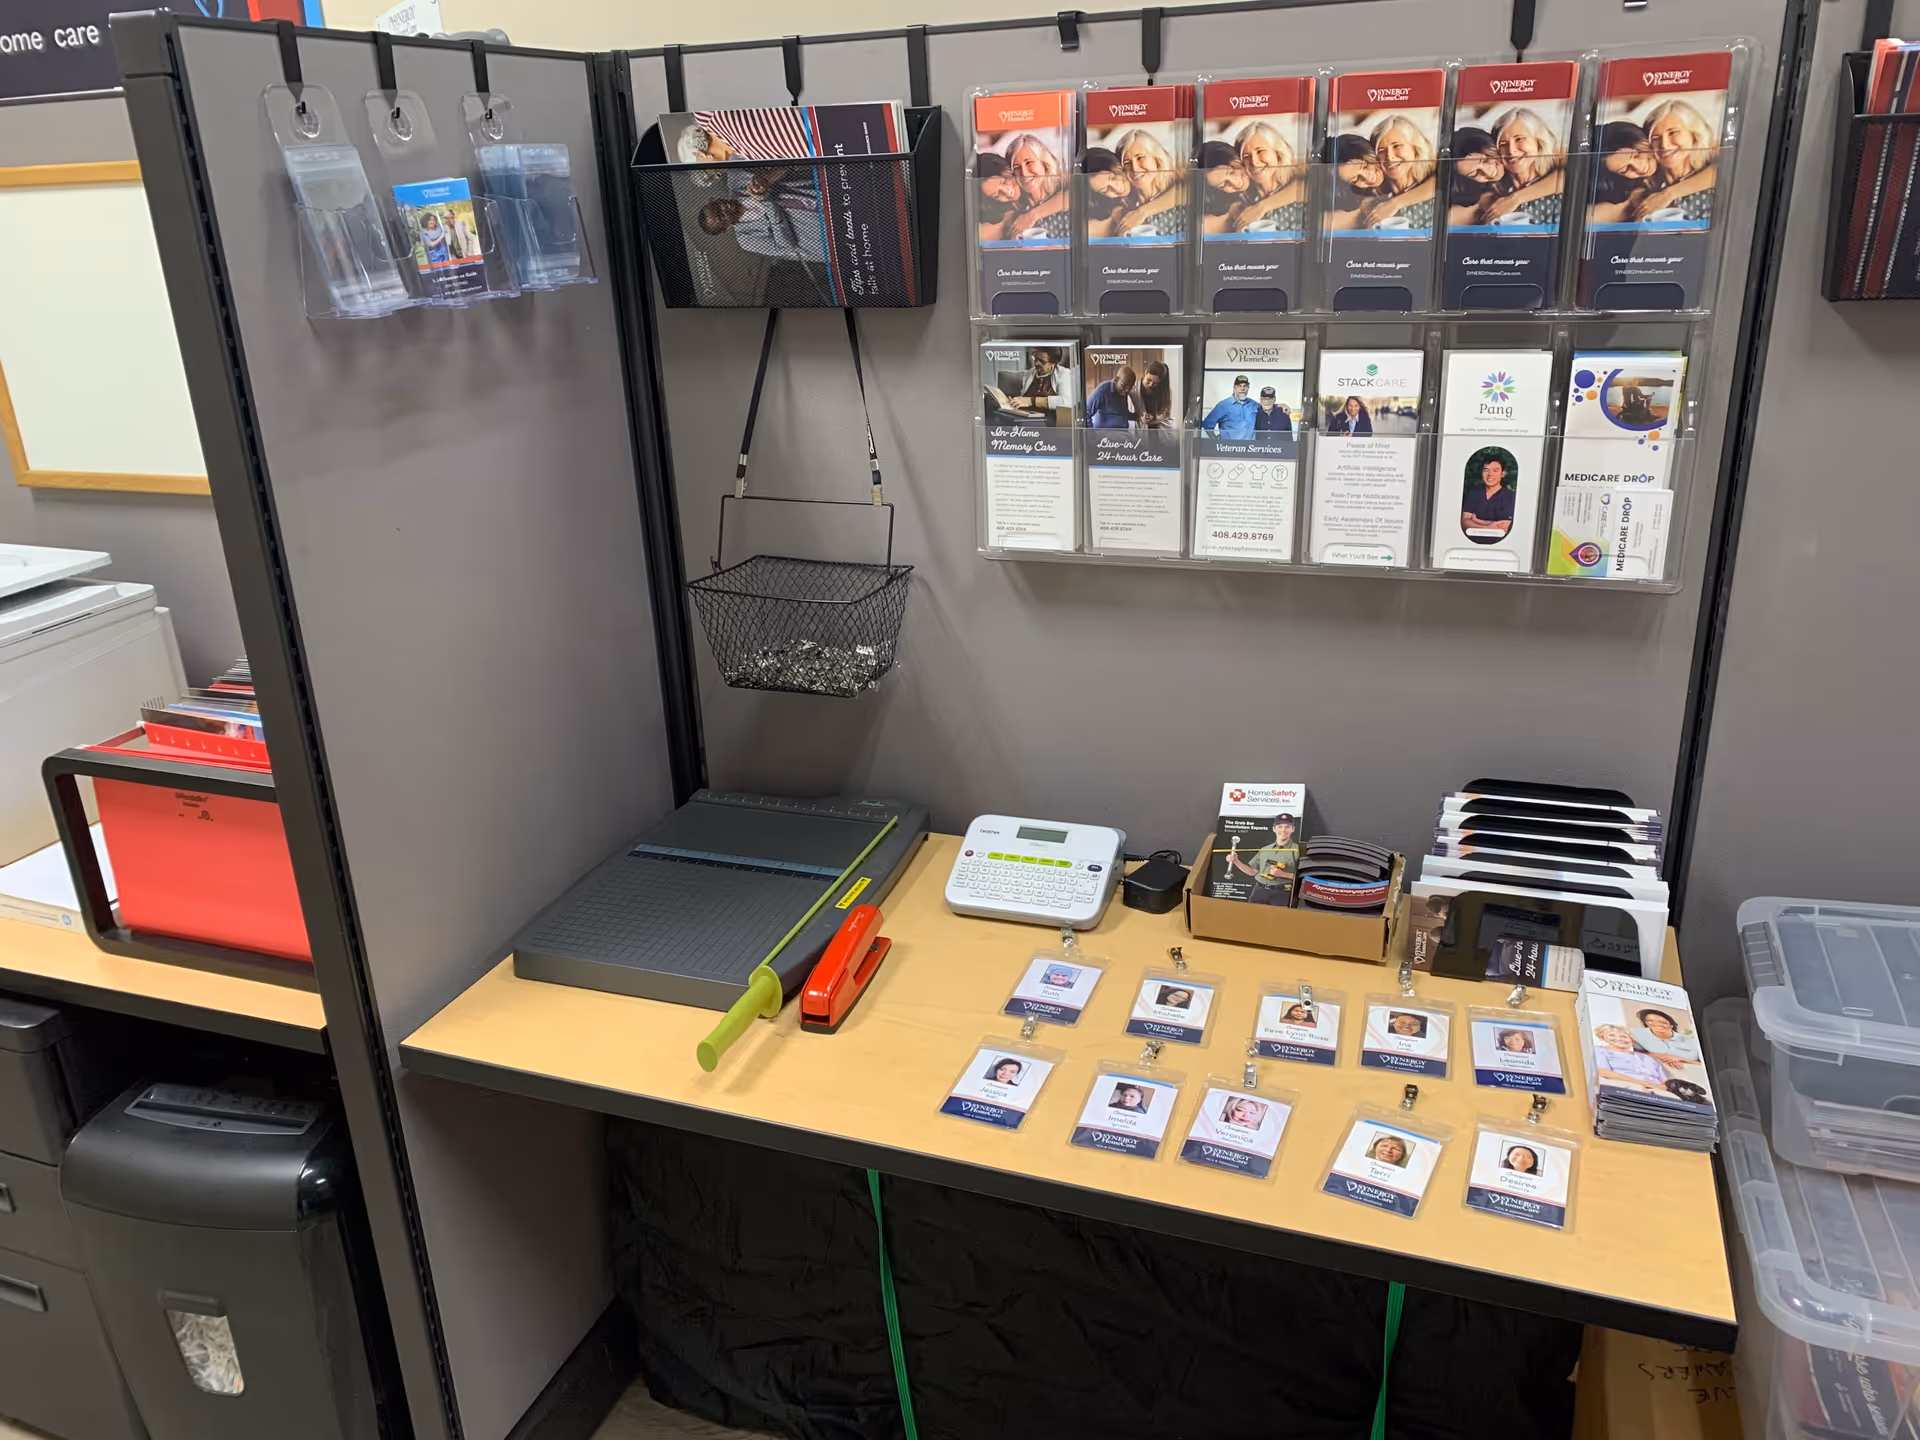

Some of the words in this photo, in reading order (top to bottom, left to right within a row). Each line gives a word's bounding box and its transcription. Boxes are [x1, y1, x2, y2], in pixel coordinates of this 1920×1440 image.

[54, 25, 100, 47] care
[1654, 70, 1693, 80] SYNERGY
[1654, 76, 1691, 86] HomeCare
[1500, 79, 1537, 89] SYNERGY
[1500, 85, 1534, 93] HomeCare
[1376, 88, 1412, 96] SYNERGY
[1377, 94, 1410, 102] HomeCare
[1239, 95, 1271, 103] SYNERGY
[1239, 100, 1269, 108] HomeCare
[1118, 104, 1148, 112] SYNERGY
[1118, 109, 1147, 117] HomeCare
[834, 143, 852, 189] prevnt
[841, 193, 851, 206] to
[843, 210, 855, 239] tools
[861, 223, 873, 257] home
[846, 244, 859, 266] and
[1611, 255, 1629, 264] Care
[1630, 255, 1646, 263] that
[1667, 256, 1683, 265] you
[864, 260, 874, 272] at
[1218, 263, 1233, 272] Care
[1266, 264, 1279, 272] you
[1346, 260, 1361, 269] Care
[1363, 260, 1377, 268] that
[1396, 262, 1411, 270] you
[1462, 257, 1478, 265] Care
[1480, 257, 1495, 265] that
[1515, 258, 1530, 267] you
[1102, 267, 1116, 275] Care
[1148, 268, 1159, 276] you
[1239, 347, 1280, 356] SYNERGY
[1239, 354, 1280, 363] HomeCare
[1479, 403, 1513, 418] Pang
[991, 426, 1040, 438] In-Home
[991, 440, 1033, 453] Memory
[1035, 441, 1057, 452] Care
[1216, 443, 1246, 453] Veteran
[1248, 444, 1282, 454] Services
[1096, 451, 1137, 462] 24-hour
[1139, 452, 1163, 463] Care
[1565, 473, 1620, 483] MEDICARE
[1623, 473, 1655, 483] DROP
[1211, 531, 1274, 541] 408.429.8769
[1616, 526, 1628, 571] MEDICARE
[1622, 497, 1632, 522] DROP
[1509, 940, 1524, 976] Live-in
[1607, 978, 1674, 997] SYNERGY
[1611, 985, 1673, 1002] HomeCare
[979, 1086, 1008, 1098] Jessica
[971, 1102, 1007, 1115] SYNERGY
[971, 1108, 1002, 1119] HomeCare
[1108, 1115, 1137, 1127] Imelda
[1102, 1133, 1139, 1144] SYNERGY
[1214, 1128, 1254, 1144] Veronica
[1102, 1138, 1137, 1149] HomeCare
[1212, 1151, 1248, 1166] HomeCare
[1213, 1146, 1252, 1161] SYNERGY
[1356, 1182, 1398, 1200] SYNERGY
[1356, 1187, 1394, 1204] HomeCare
[1500, 1194, 1544, 1212] SYNERGY
[1500, 1199, 1540, 1214] HomeCare
